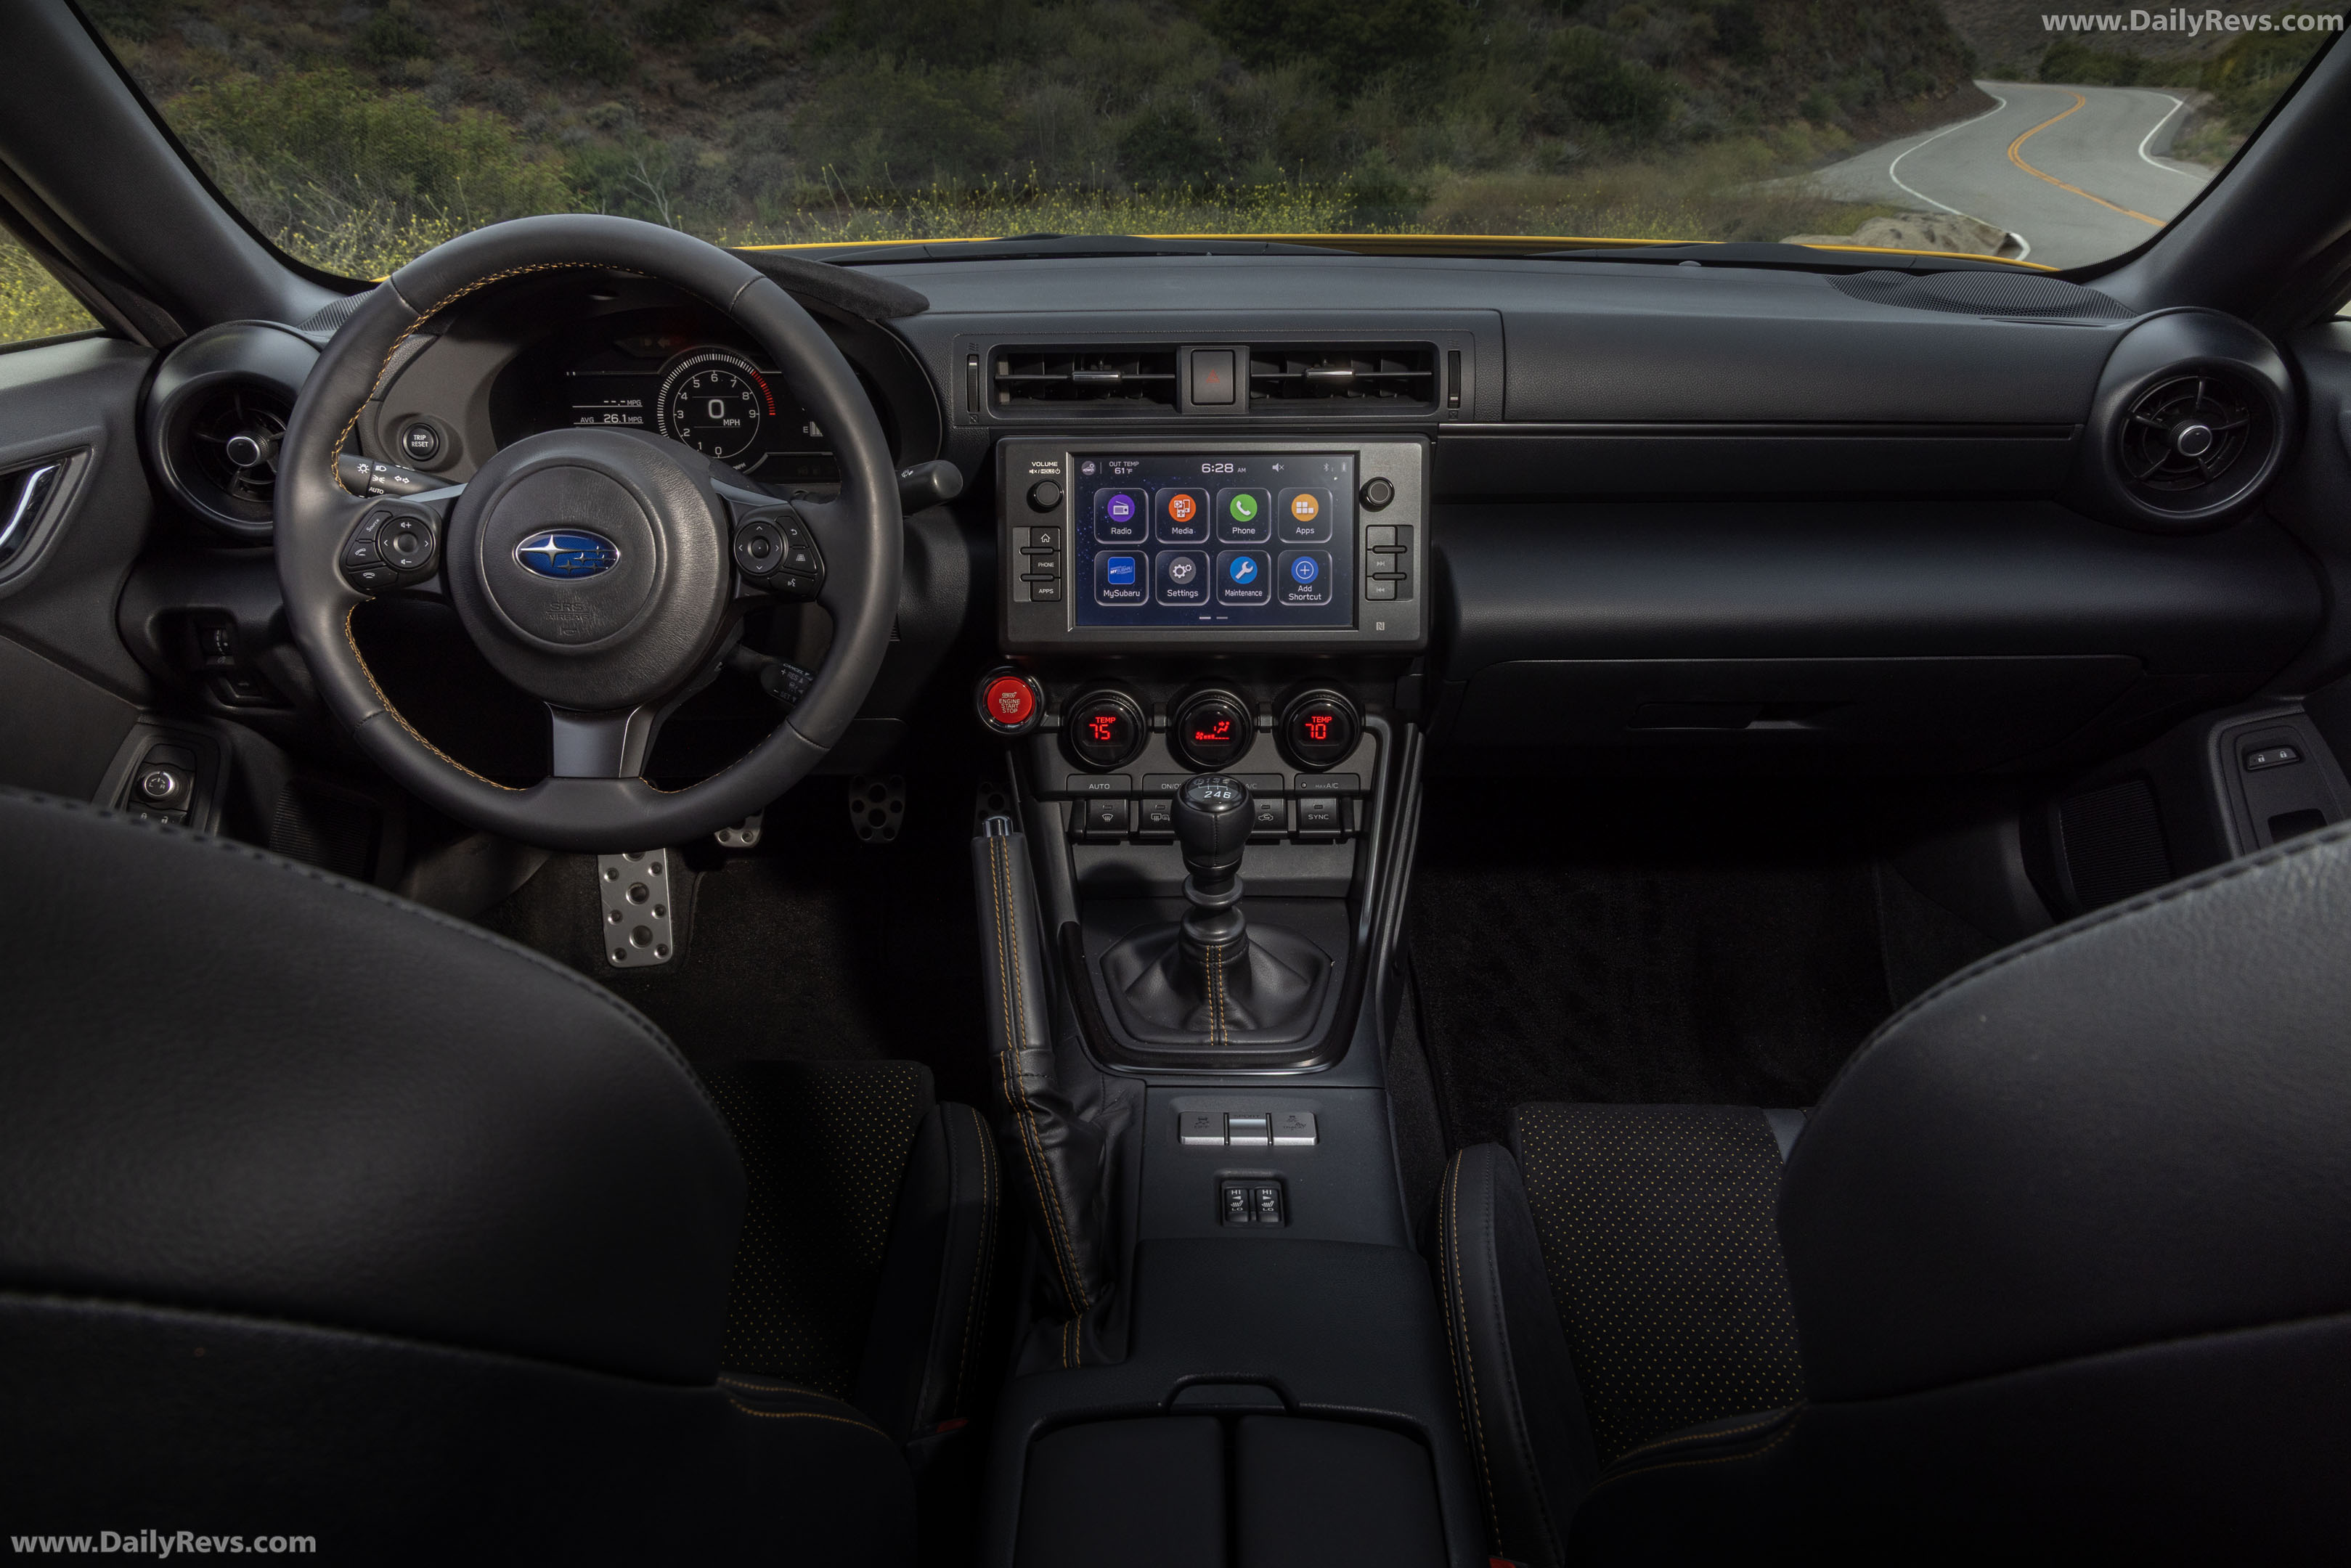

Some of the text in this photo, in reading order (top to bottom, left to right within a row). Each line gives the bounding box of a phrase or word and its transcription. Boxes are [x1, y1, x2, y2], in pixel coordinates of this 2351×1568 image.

[711, 373, 719, 382] 6
[693, 380, 701, 388] 5
[730, 380, 737, 388] 7
[680, 392, 688, 401] 4
[742, 392, 750, 401] 8
[708, 399, 725, 419] 0
[749, 409, 757, 418] 9
[603, 414, 627, 423] 26.1
[677, 409, 684, 419] 3
[683, 428, 690, 437] 2
[698, 441, 702, 450] 1
[714, 446, 722, 455] 0
[1202, 463, 1234, 473] 6:28
[366, 518, 380, 532] Source
[1103, 589, 1140, 598] MySubaru
[1167, 589, 1199, 598] Settings
[783, 663, 804, 674] CANCEL
[787, 671, 799, 682] RES
[1089, 724, 1111, 740] 75
[1305, 723, 1327, 740] 70
